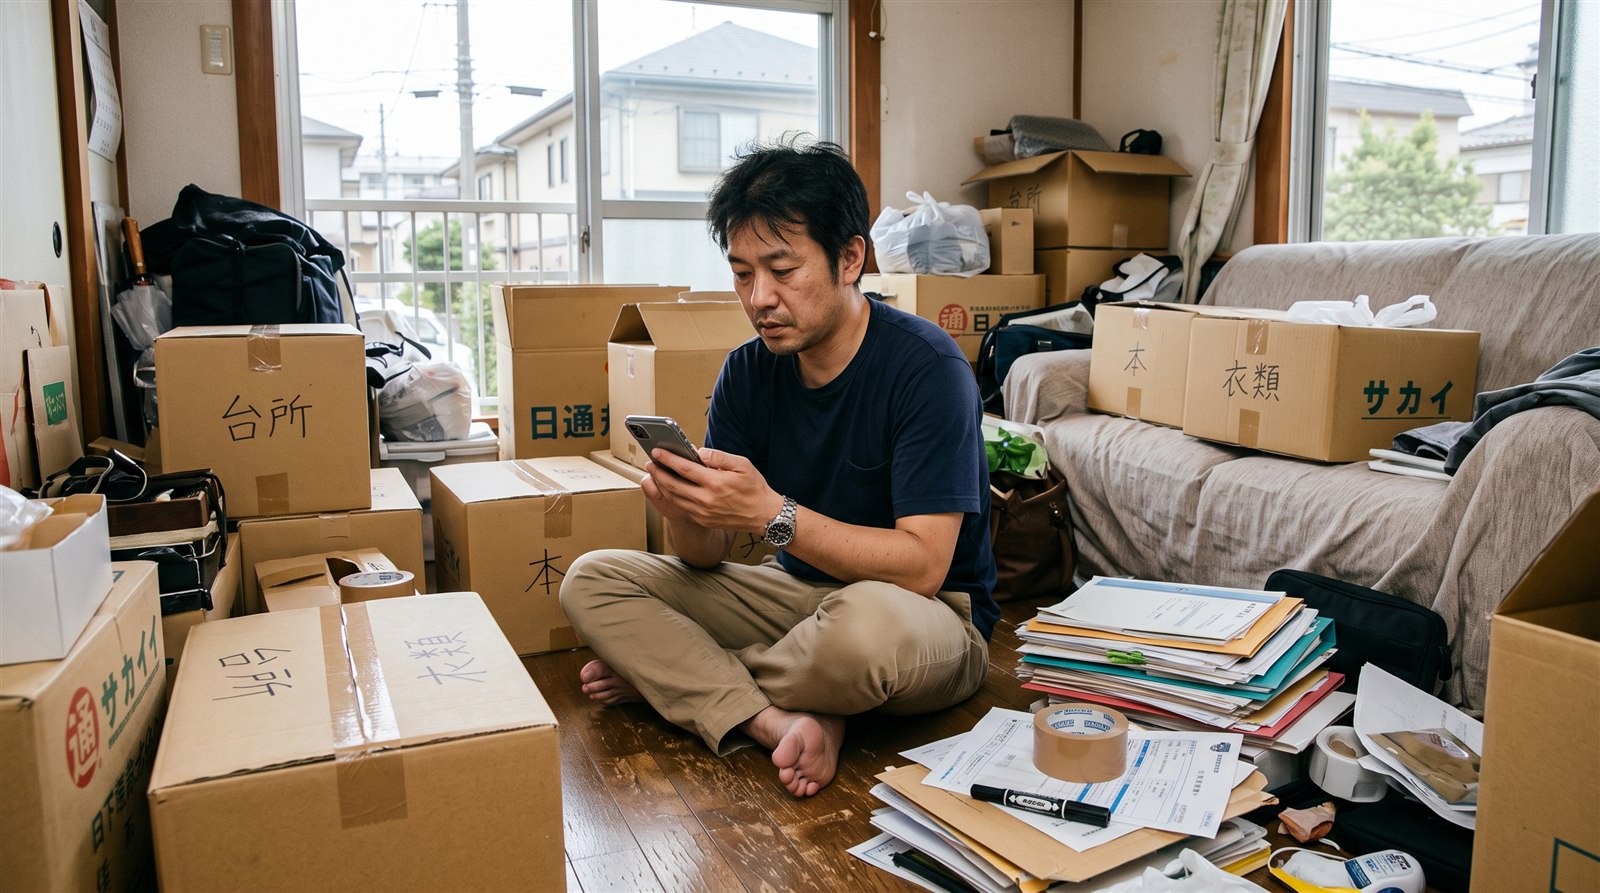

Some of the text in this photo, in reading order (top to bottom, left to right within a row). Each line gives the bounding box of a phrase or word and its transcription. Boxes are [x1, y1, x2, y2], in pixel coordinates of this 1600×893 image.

[1009, 183, 1042, 215] 台所
[939, 305, 967, 336] 通
[1123, 341, 1148, 377] 本
[1223, 358, 1281, 403] 衣類
[222, 393, 313, 442] 台所
[1363, 380, 1454, 415] サカイ
[524, 548, 566, 595] 本
[212, 647, 292, 701] 台所
[404, 631, 487, 685] 衣類
[67, 688, 99, 786] 通
